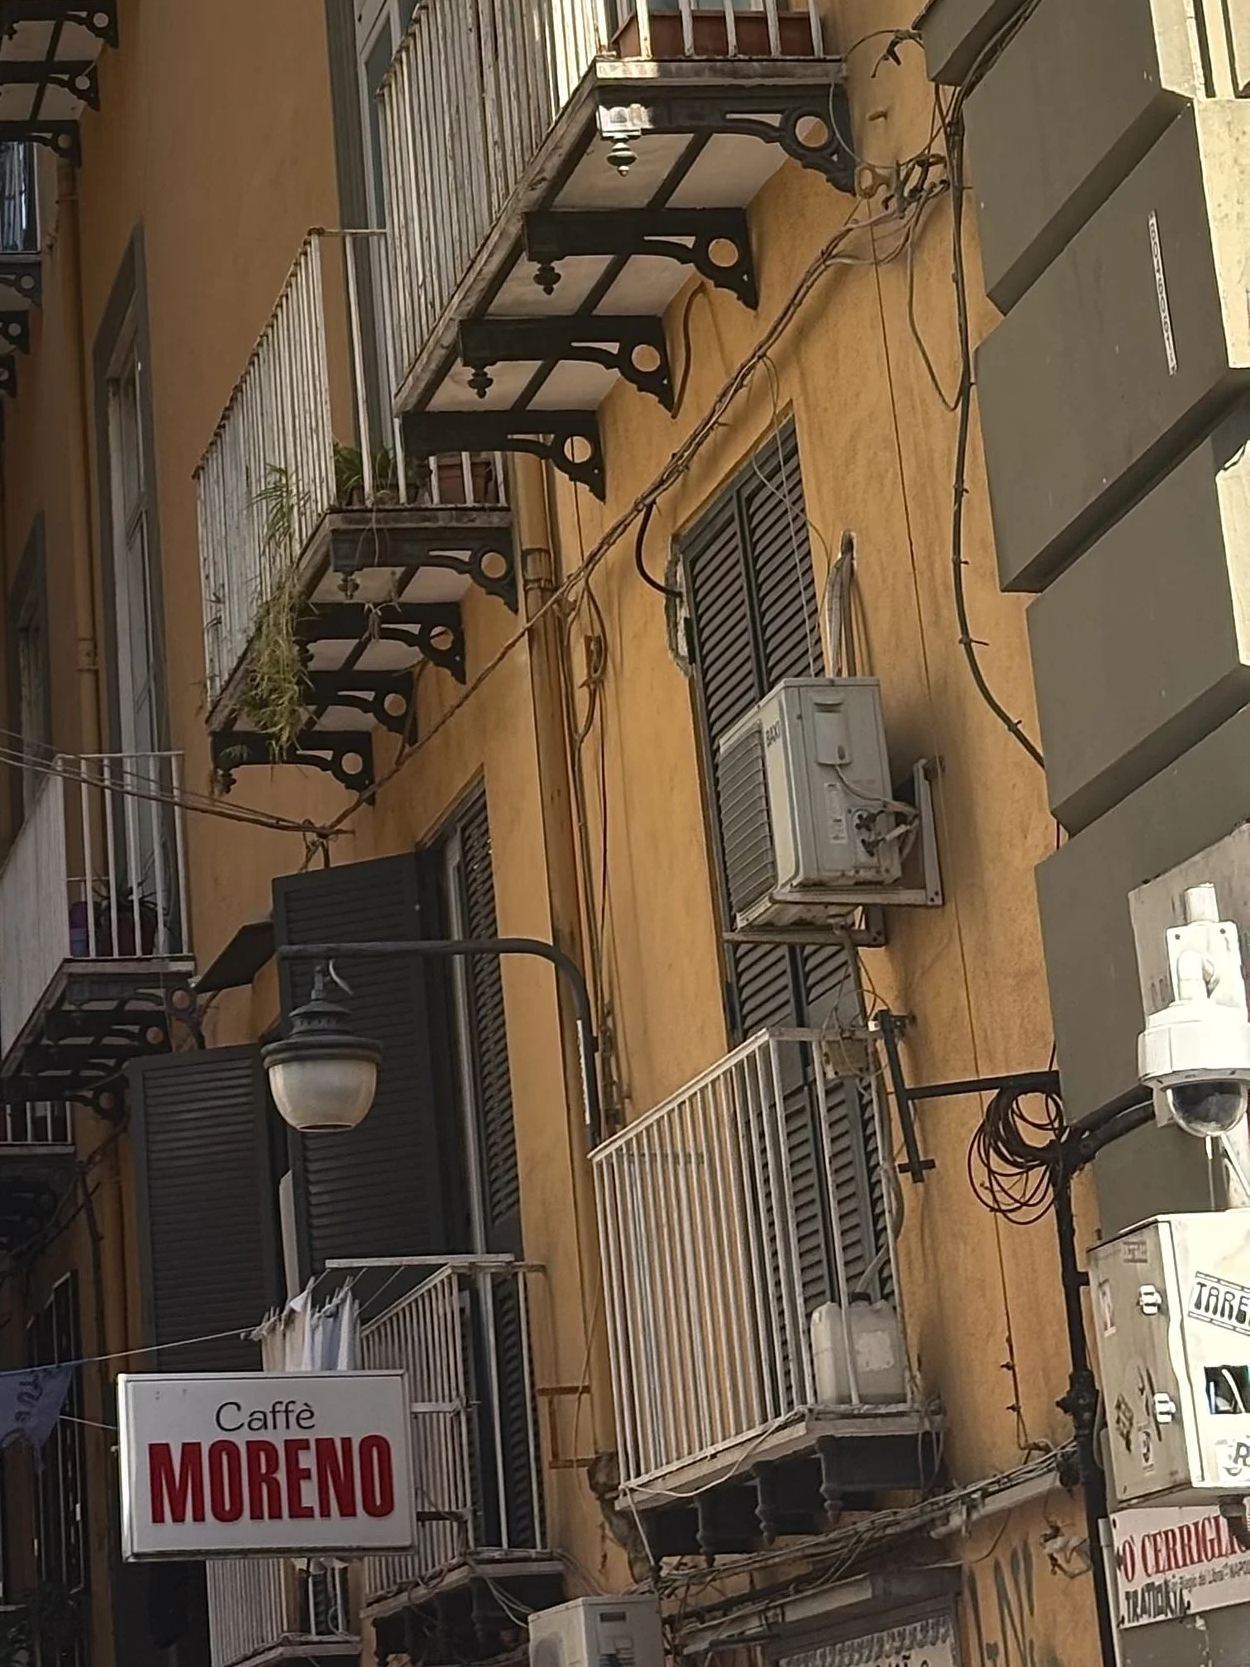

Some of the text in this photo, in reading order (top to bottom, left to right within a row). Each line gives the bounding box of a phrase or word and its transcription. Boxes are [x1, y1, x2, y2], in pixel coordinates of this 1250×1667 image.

[1194, 1281, 1250, 1326] TARE
[215, 1400, 316, 1432] Caffè
[148, 1434, 395, 1525] MORENO
[1141, 1514, 1249, 1578] CERRIGLI
